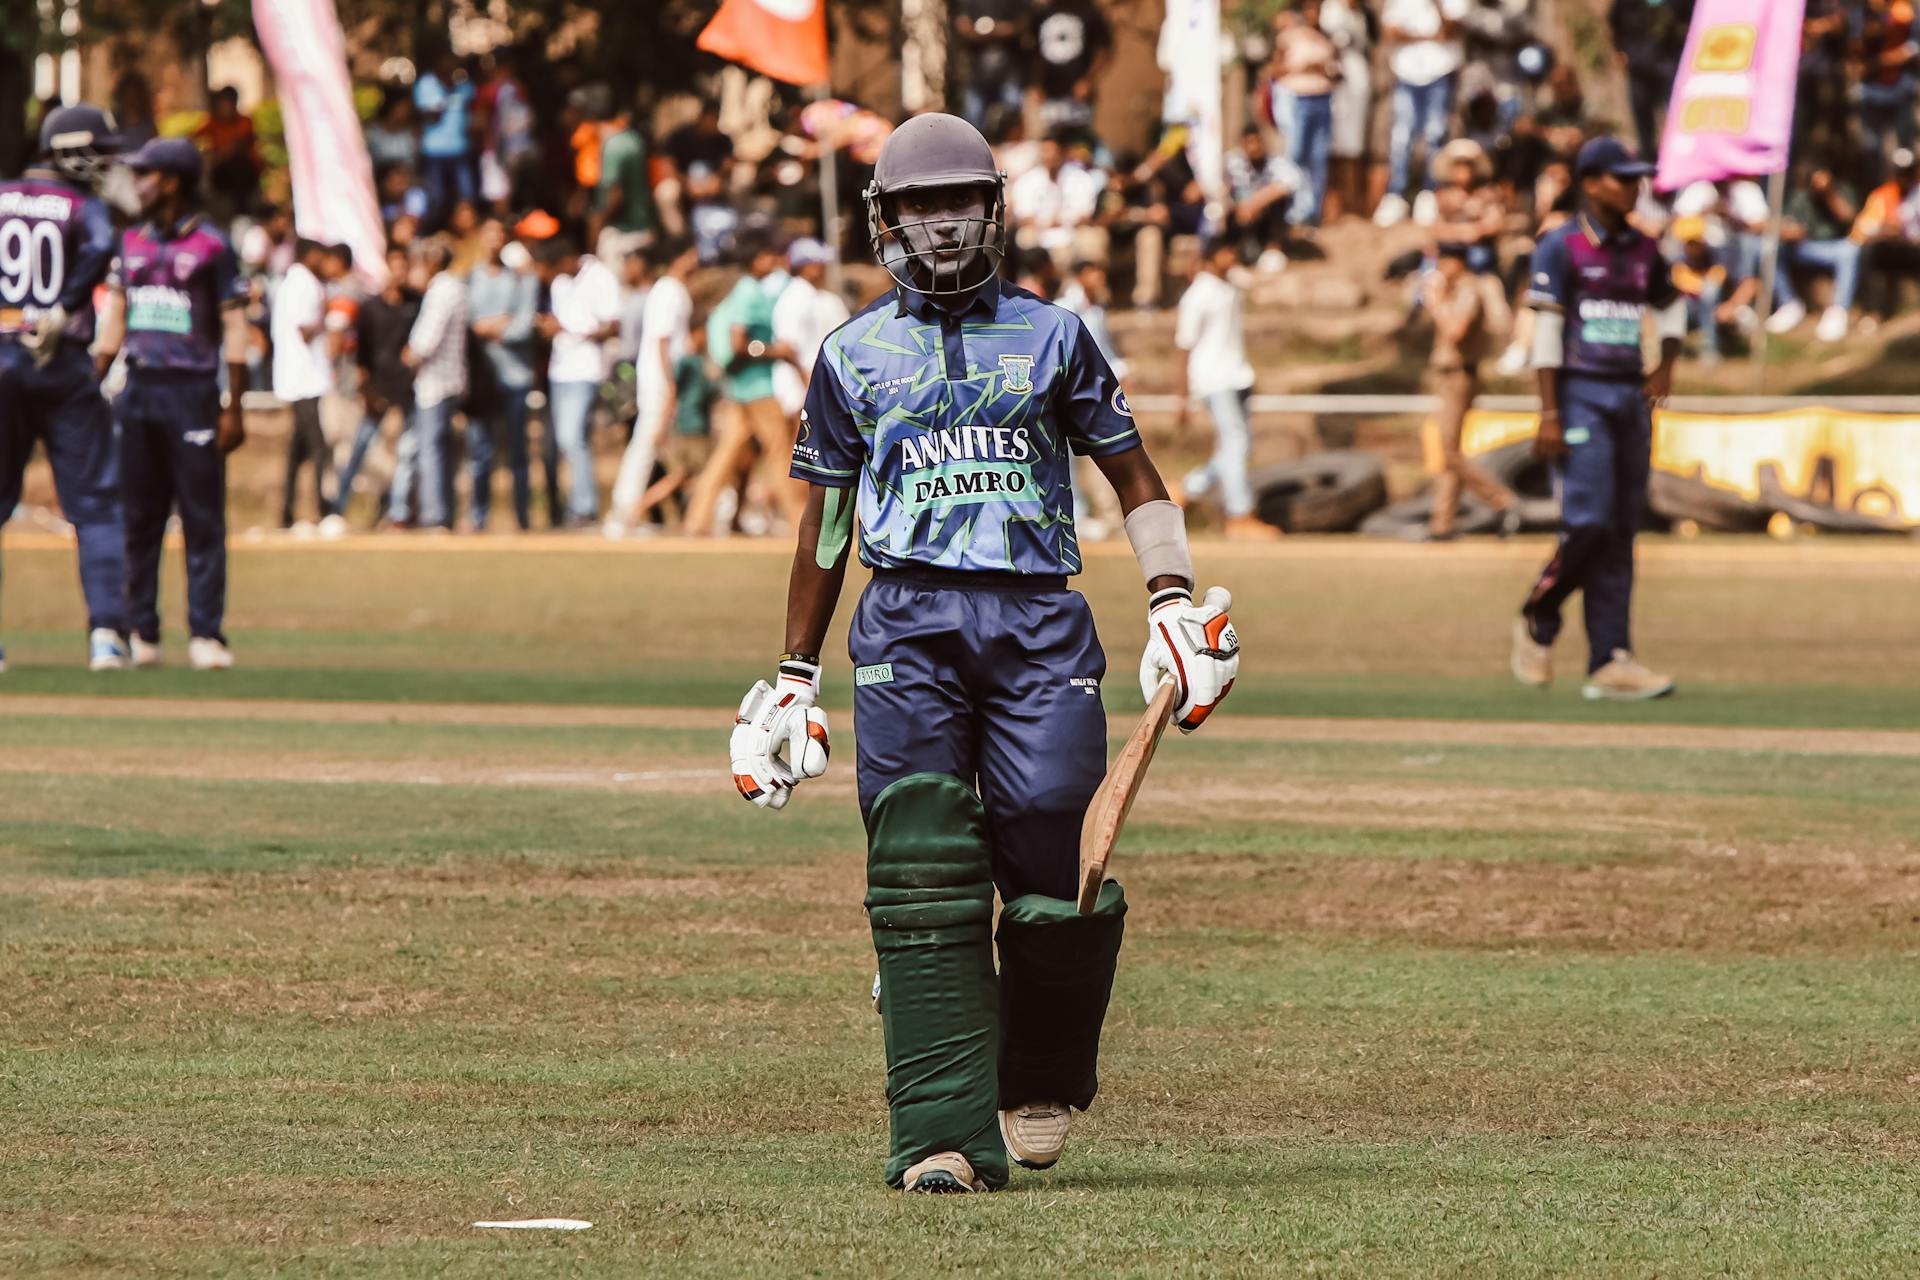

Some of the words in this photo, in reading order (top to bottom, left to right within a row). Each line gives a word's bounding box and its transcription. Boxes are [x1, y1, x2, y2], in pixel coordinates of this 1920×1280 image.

[0, 218, 64, 303] 90
[901, 425, 1029, 470] ANNITES
[915, 471, 1026, 503] DAMRO
